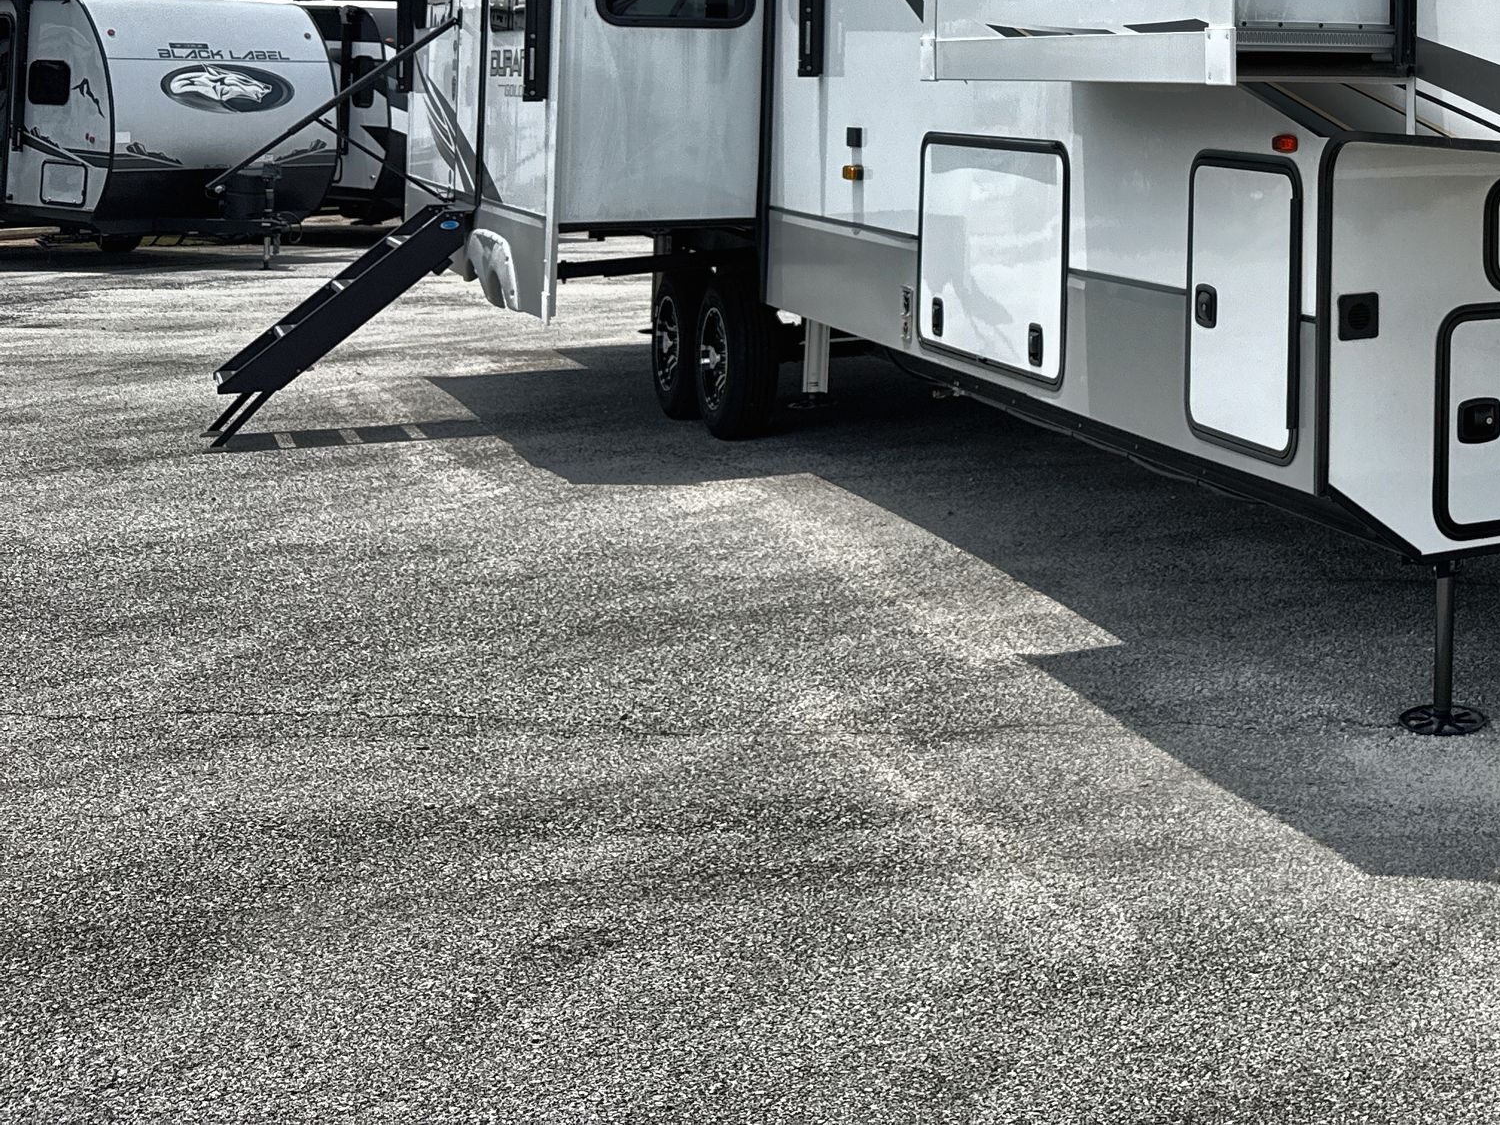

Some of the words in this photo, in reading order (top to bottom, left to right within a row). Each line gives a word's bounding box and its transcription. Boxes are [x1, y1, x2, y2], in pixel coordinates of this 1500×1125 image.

[157, 48, 224, 59] BLACK
[229, 50, 290, 61] LABEL
[489, 49, 525, 77] DURA
